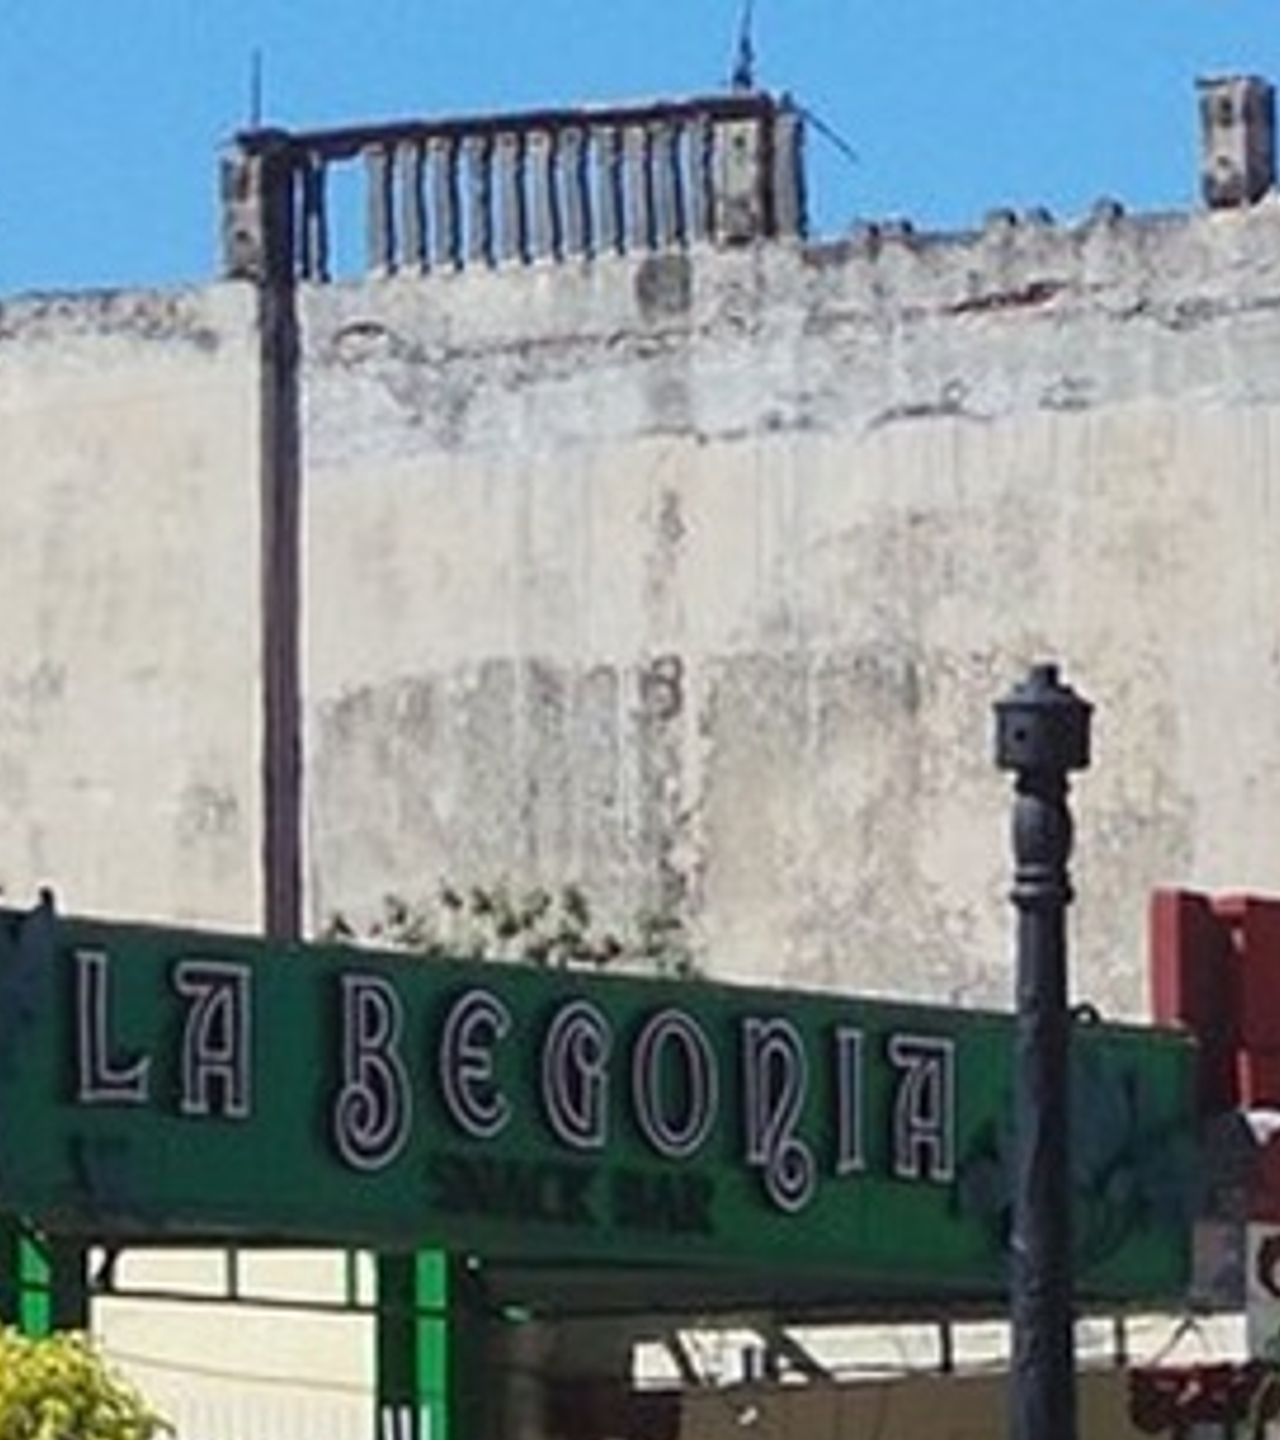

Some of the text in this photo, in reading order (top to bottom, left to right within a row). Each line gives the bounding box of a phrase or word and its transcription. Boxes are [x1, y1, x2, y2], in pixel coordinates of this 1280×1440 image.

[75, 950, 957, 1213] LA BEGONIA
[426, 1151, 715, 1236] SNACK BAR
